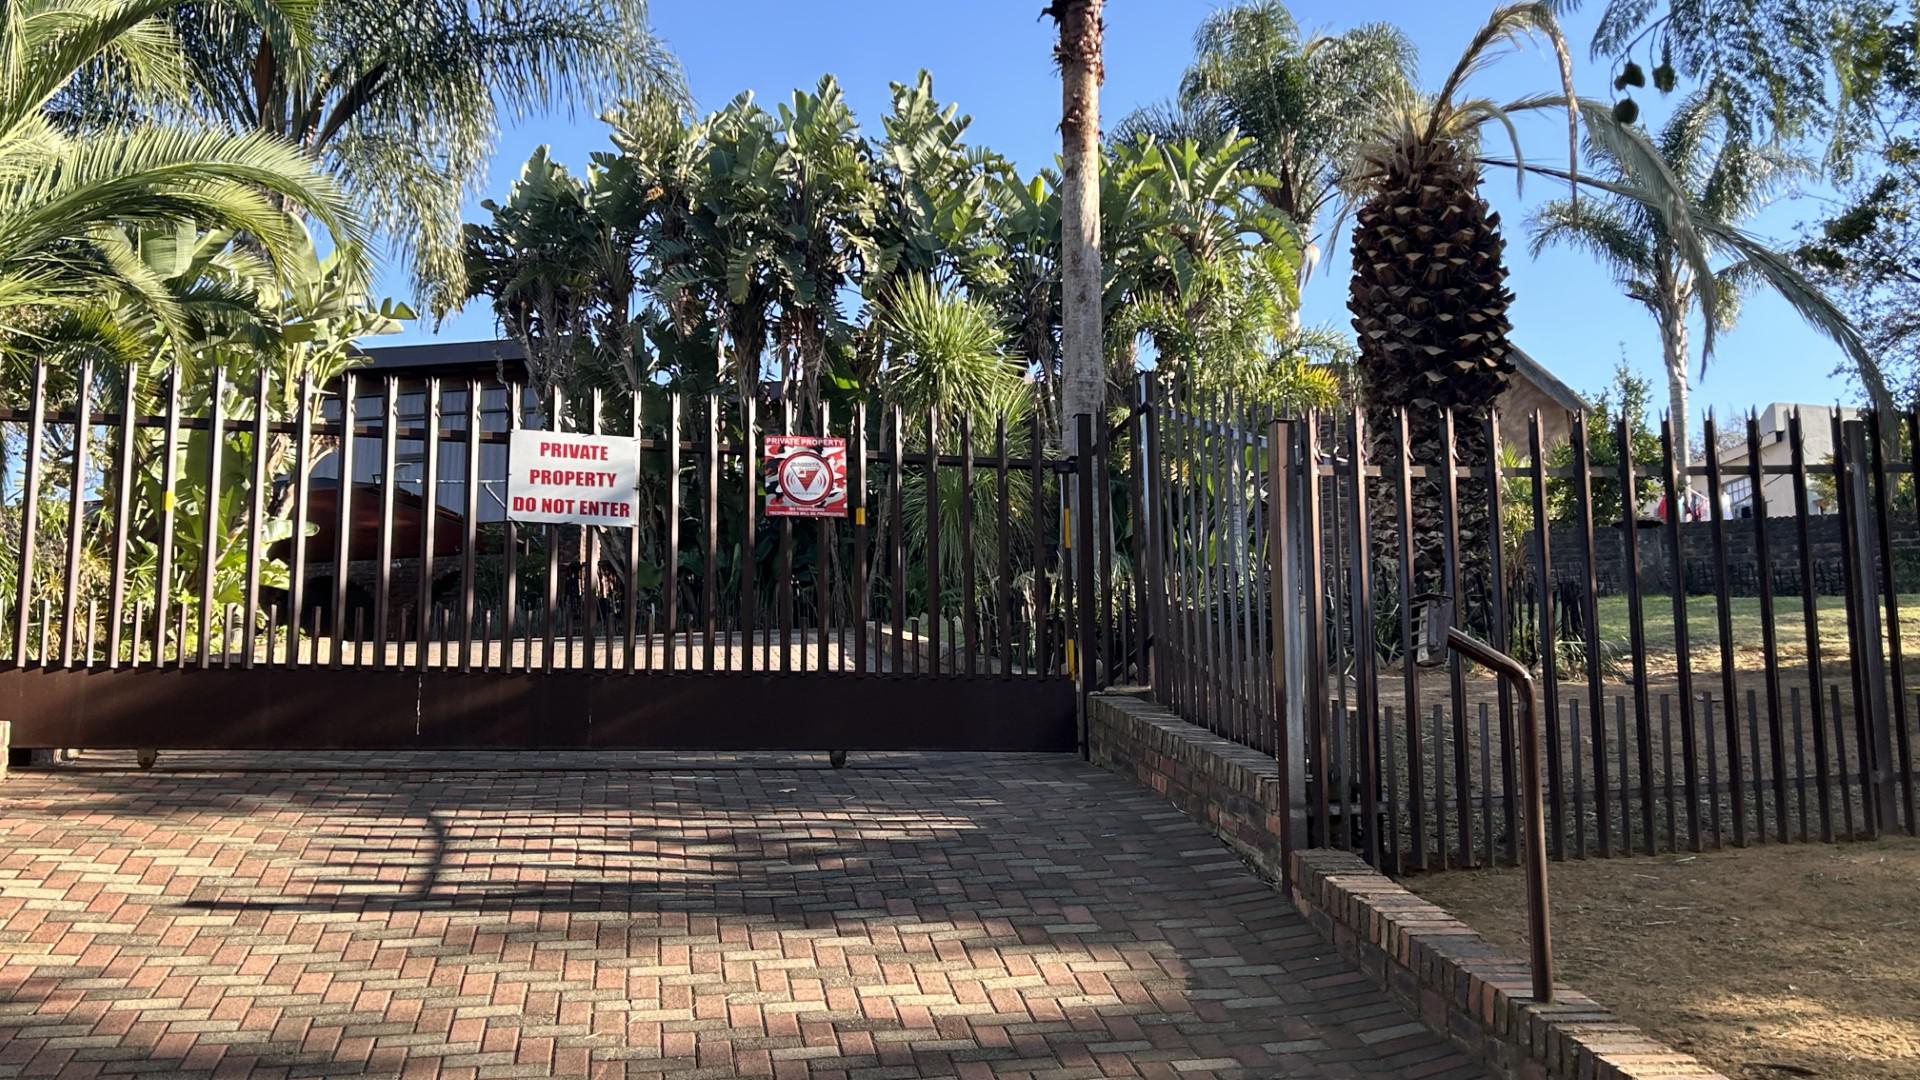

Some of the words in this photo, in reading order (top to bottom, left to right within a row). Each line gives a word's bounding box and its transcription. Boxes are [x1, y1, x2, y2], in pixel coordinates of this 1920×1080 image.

[766, 437, 800, 445] PRIVATE
[801, 438, 844, 446] PROPERTY
[540, 442, 608, 461] PRIVATE
[529, 469, 617, 488] PROPERTY
[513, 496, 536, 512] DO
[542, 498, 575, 514] NOT
[579, 500, 630, 517] ENTER
